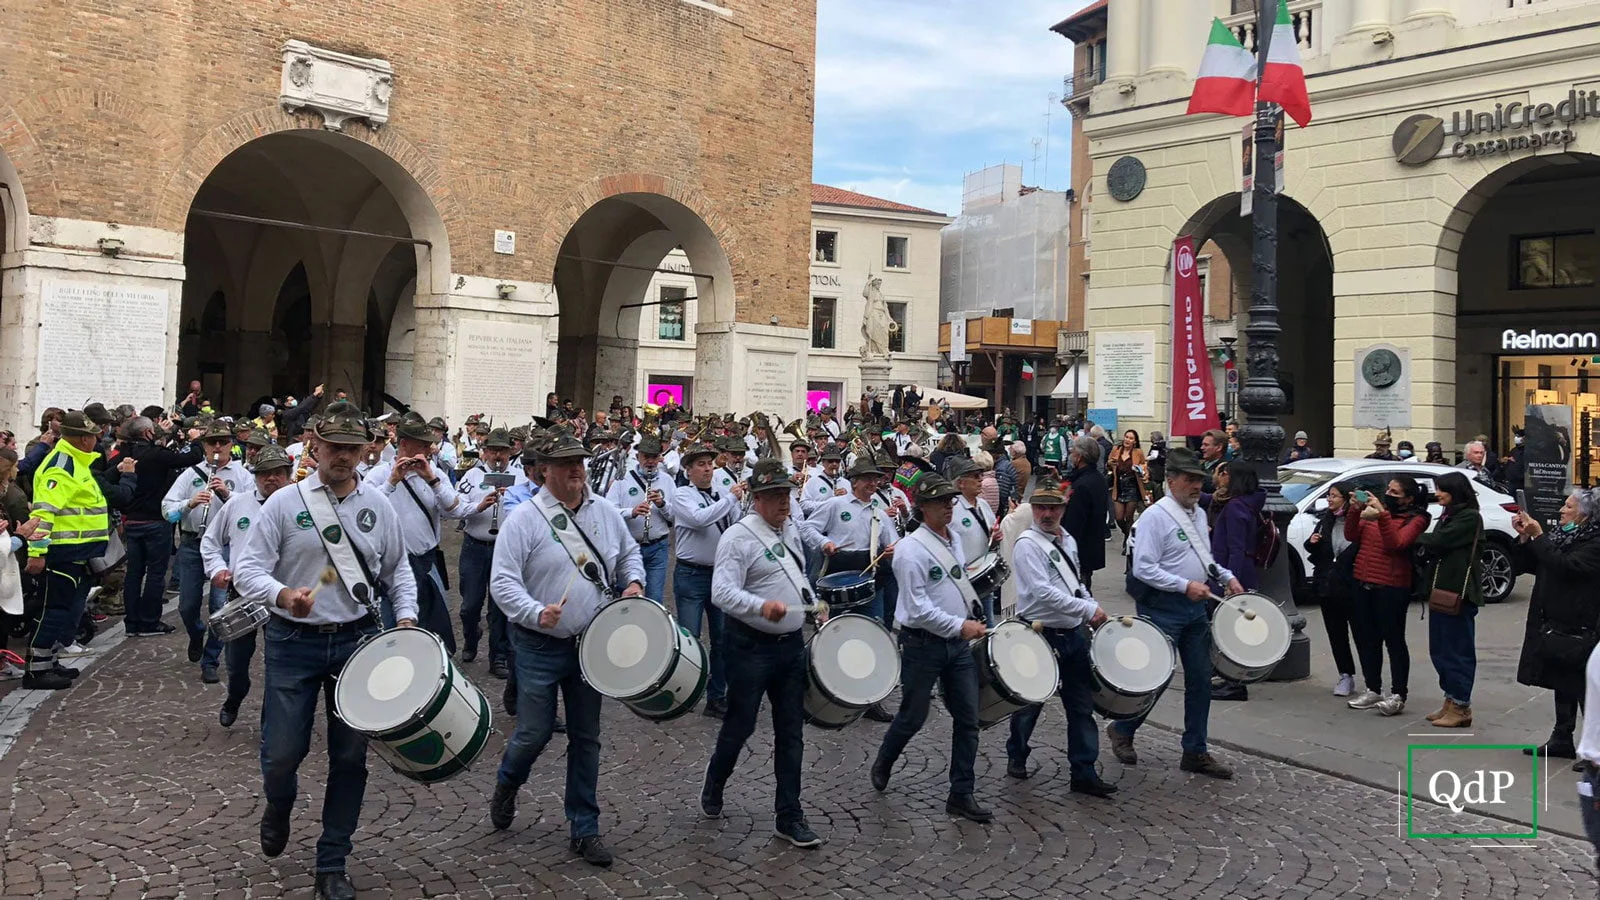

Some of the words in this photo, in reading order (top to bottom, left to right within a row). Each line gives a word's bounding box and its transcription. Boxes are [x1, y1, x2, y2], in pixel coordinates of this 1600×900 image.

[1452, 90, 1600, 137] UniCredit
[1453, 129, 1577, 158] Cassamarca
[1502, 328, 1597, 349] fielmann
